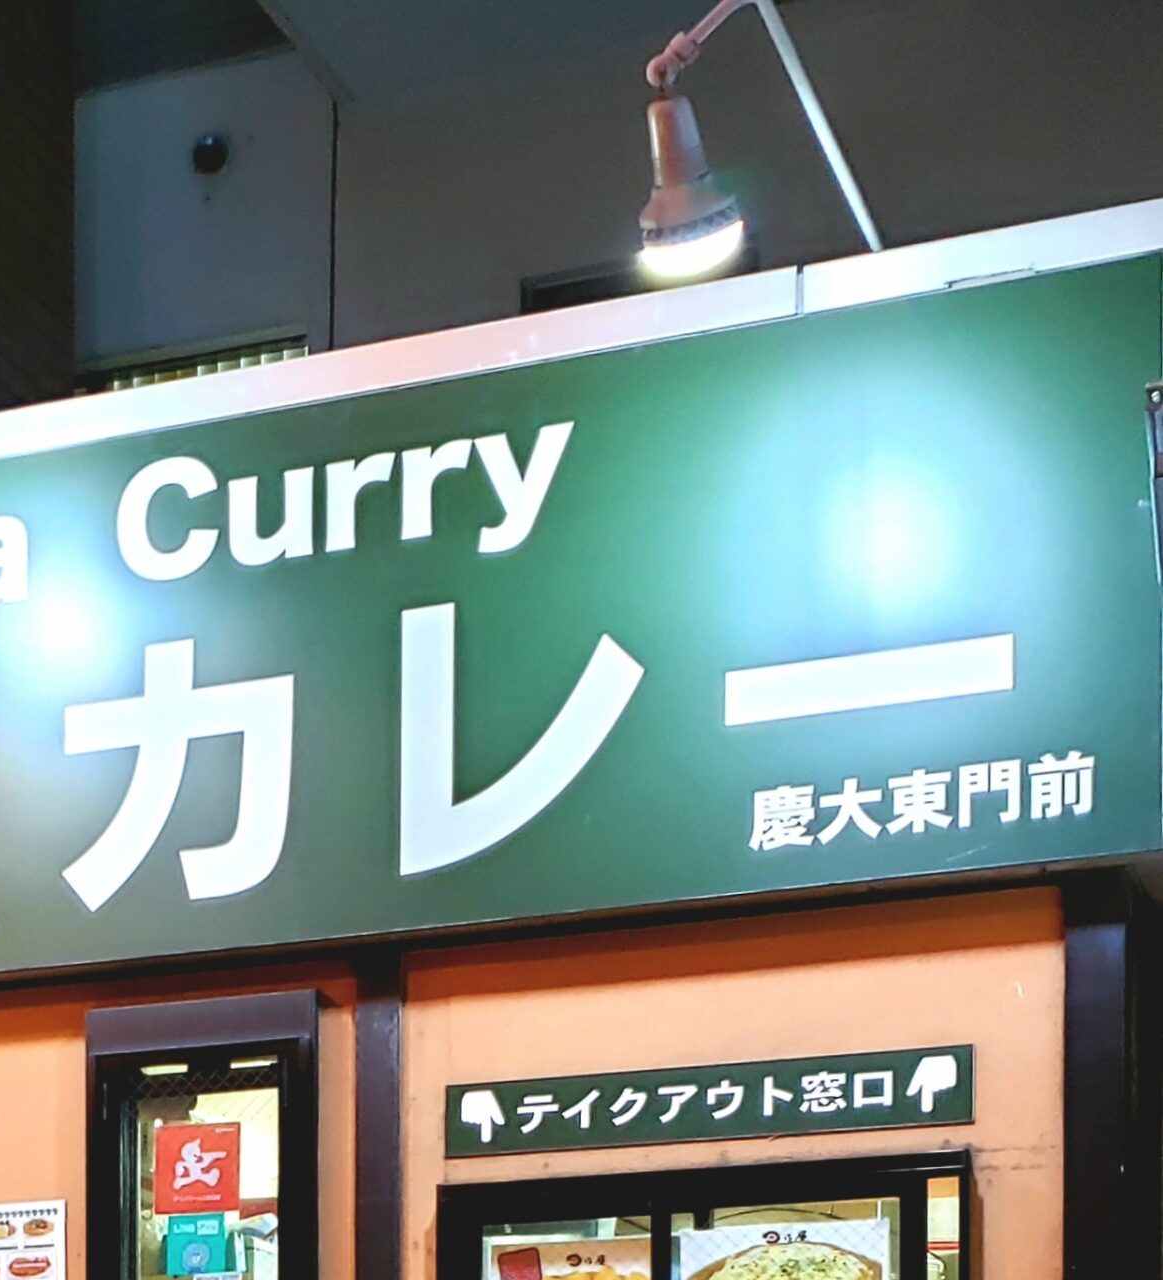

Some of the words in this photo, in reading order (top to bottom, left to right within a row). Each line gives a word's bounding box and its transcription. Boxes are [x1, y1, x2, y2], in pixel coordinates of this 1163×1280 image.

[115, 420, 575, 582] Curry
[749, 751, 1097, 855] 慶大東門前
[516, 1070, 893, 1135] テイクアウト窓口
